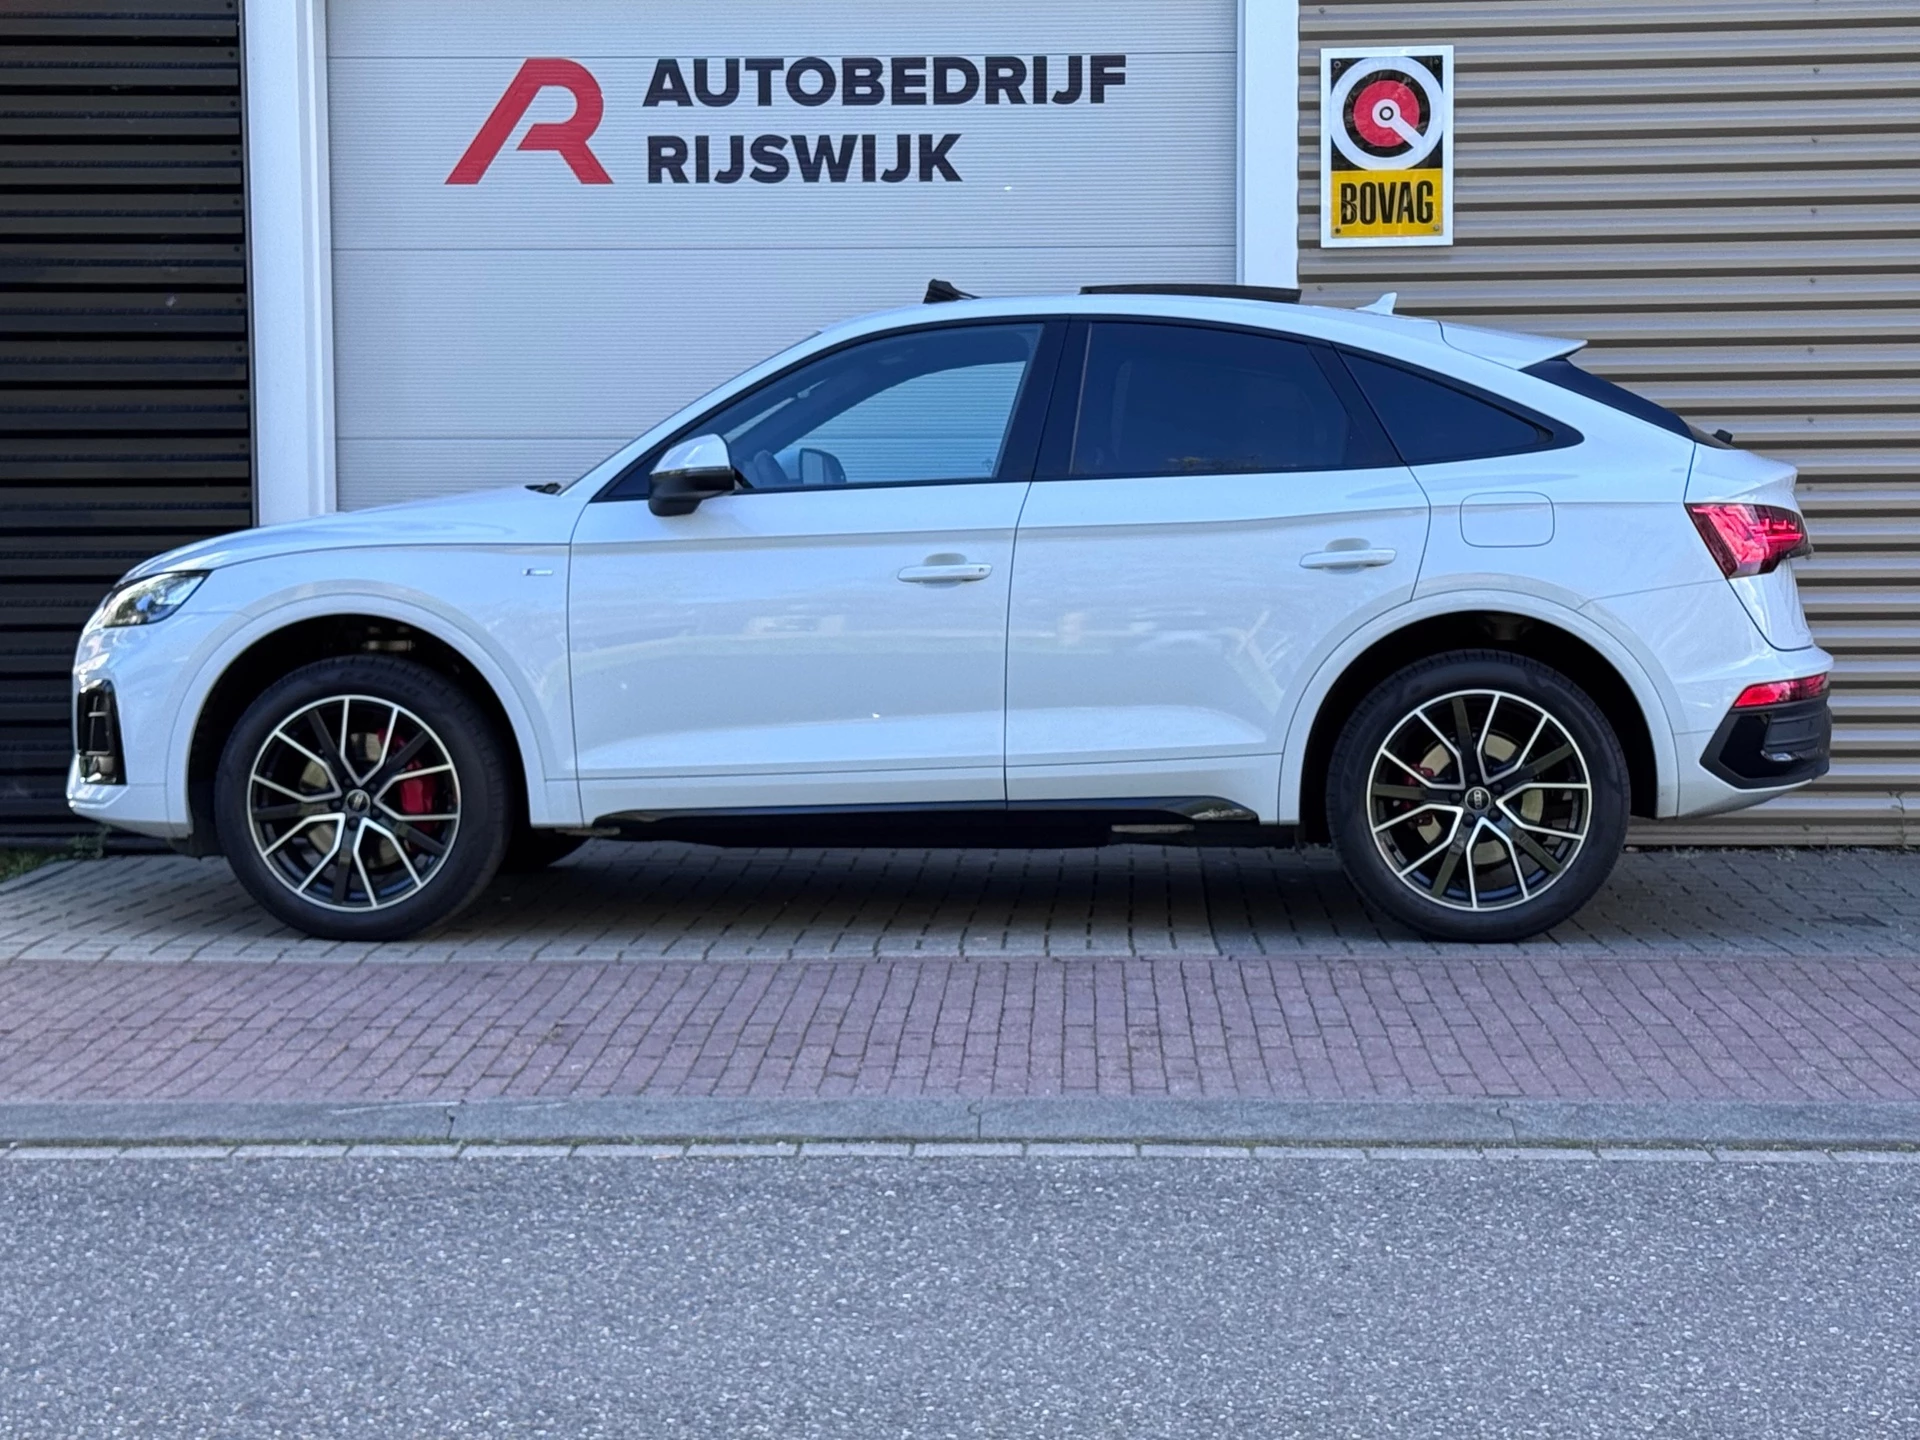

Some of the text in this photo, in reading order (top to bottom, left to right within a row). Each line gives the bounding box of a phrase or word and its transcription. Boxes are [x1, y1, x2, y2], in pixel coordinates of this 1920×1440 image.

[643, 55, 1126, 107] AUTOBEDRIJF
[647, 133, 962, 184] RIJSWIJK
[1340, 180, 1434, 226] BOVAG
